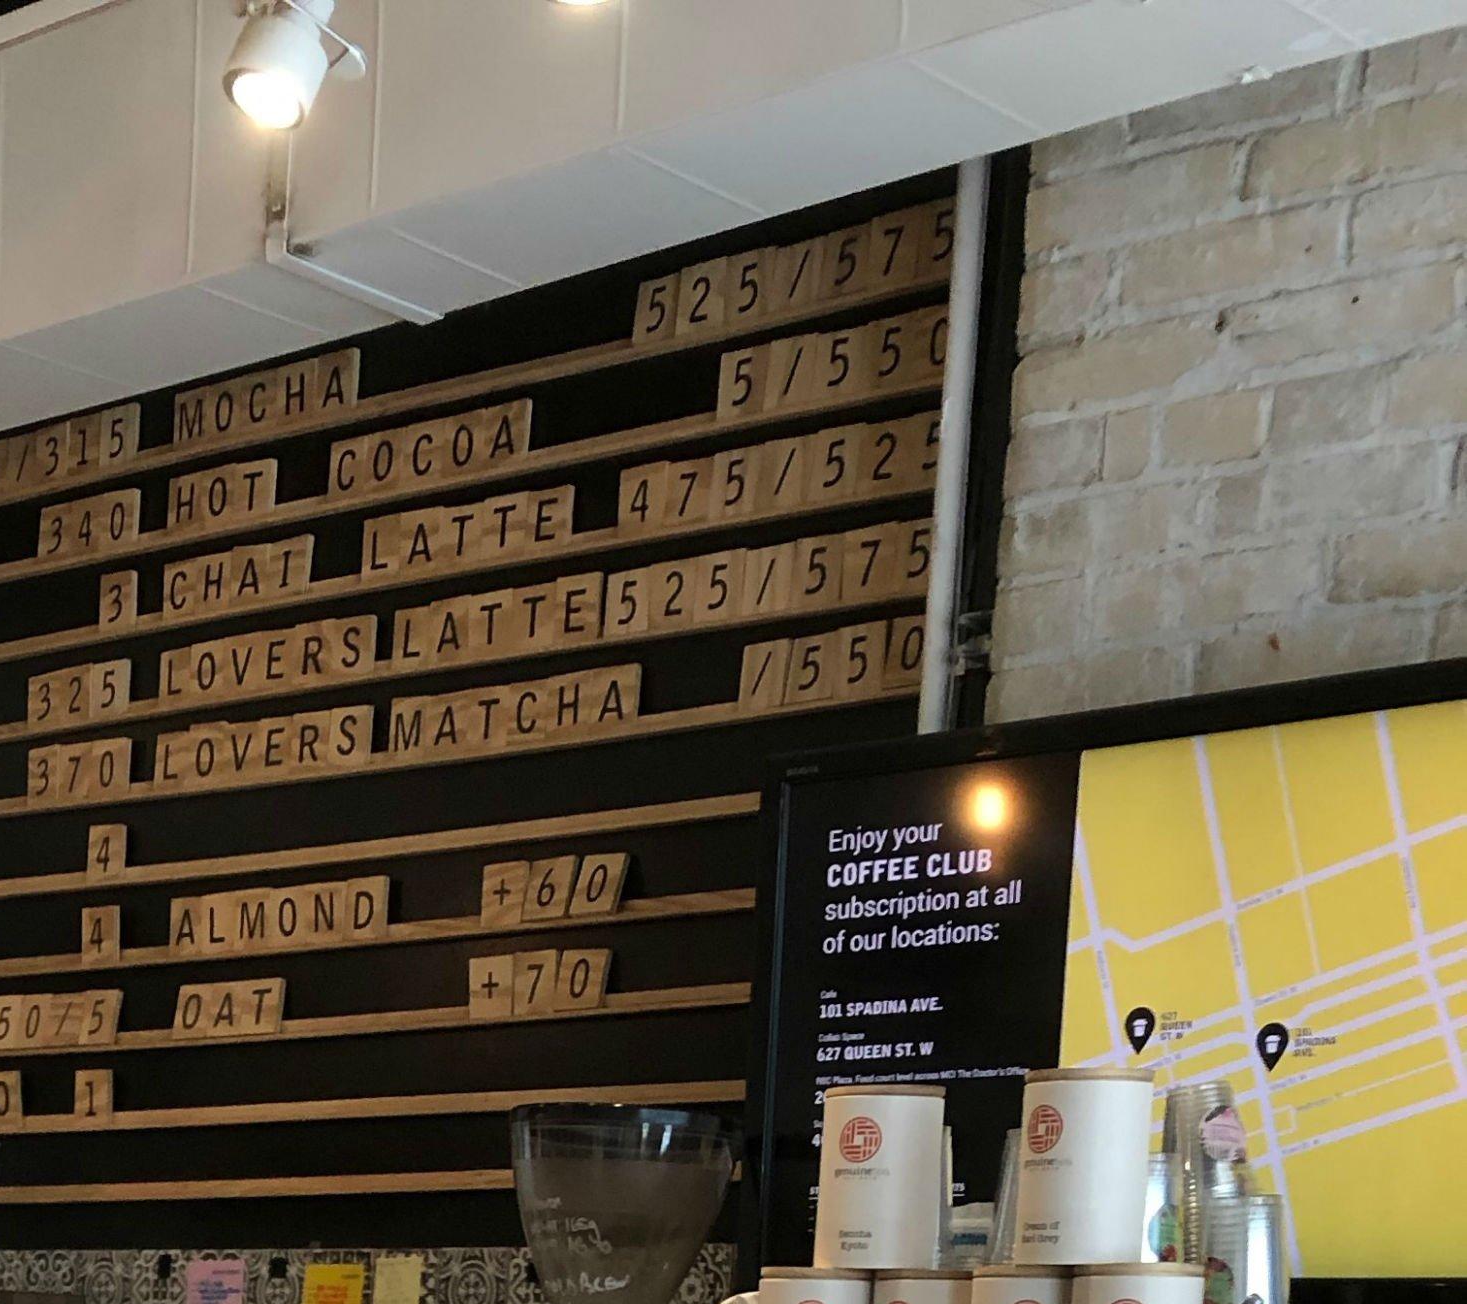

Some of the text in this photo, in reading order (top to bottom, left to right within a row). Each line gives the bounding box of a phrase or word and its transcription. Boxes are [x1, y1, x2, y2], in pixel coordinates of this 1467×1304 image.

[178, 208, 954, 441] MOCHA 525/575
[176, 318, 946, 523] HOT COCOA 5/550
[47, 502, 125, 554] 340
[170, 421, 940, 610] CHAI LATTE 475/525
[107, 584, 123, 622] 3
[167, 528, 930, 696] LOVERS LATTE 525/575
[37, 669, 115, 721] 325
[163, 626, 923, 780] LOVERS MATCHA /550
[35, 752, 114, 795] 370
[96, 836, 110, 873] 4
[828, 823, 943, 856] Enjoy your
[827, 849, 992, 888] COFFEE CLUB
[176, 863, 608, 946] ALMOND +60
[824, 879, 1023, 921] subscription at all
[90, 918, 104, 953] 4
[822, 920, 1000, 954] of our locations:
[181, 958, 589, 1029] OAT +70
[819, 1003, 843, 1019] 101
[846, 999, 907, 1017] SPADINA
[816, 1041, 934, 1062] 627 QUEEN ST. W
[85, 1082, 97, 1117] 1
